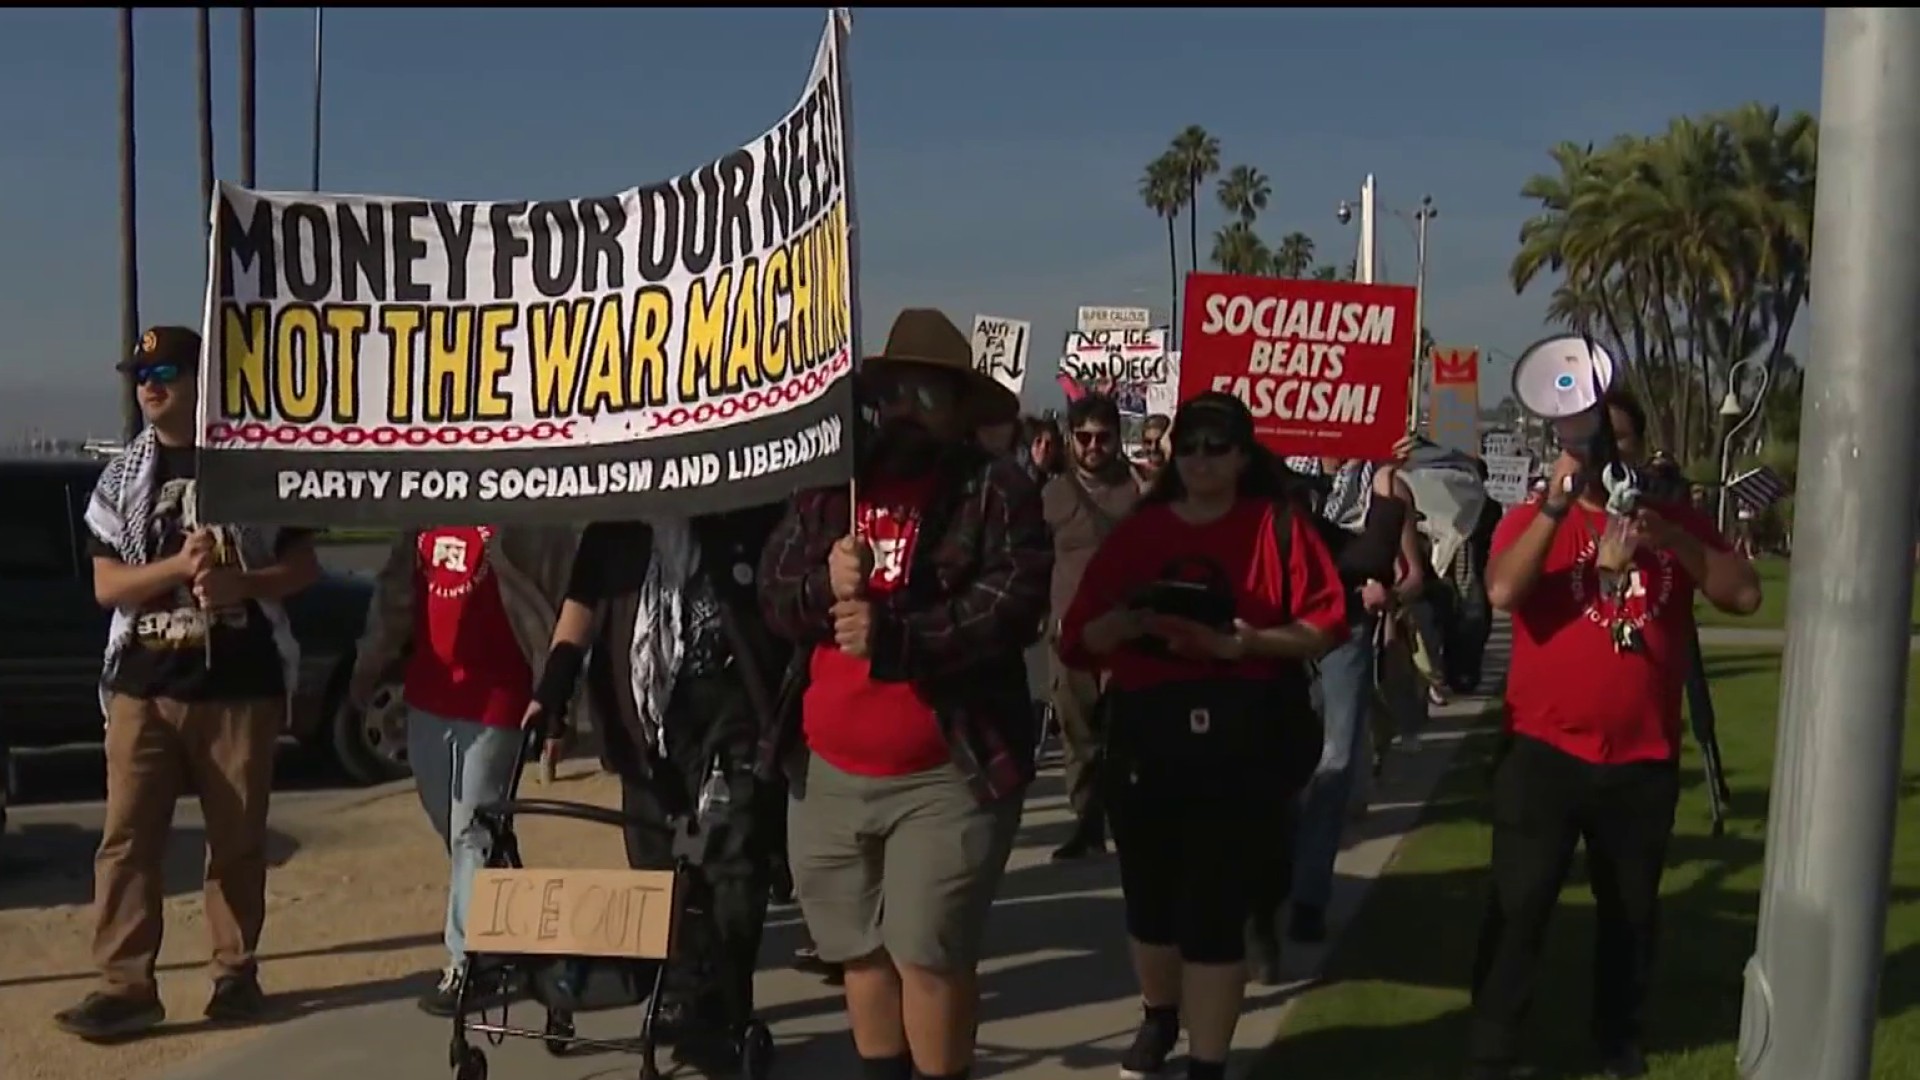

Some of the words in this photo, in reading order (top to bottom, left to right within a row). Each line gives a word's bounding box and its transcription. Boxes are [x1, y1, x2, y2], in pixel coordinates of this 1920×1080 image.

[221, 200, 476, 300] MONEY
[494, 197, 625, 300] FOR
[638, 148, 753, 281] OUR
[221, 301, 365, 425] NOT
[379, 302, 515, 424] THE
[527, 283, 669, 418] WAR
[678, 202, 849, 403] MACHIN
[1072, 330, 1110, 346] NO
[1123, 328, 1151, 344] ICE
[1202, 293, 1396, 345] SOCIALISM
[976, 353, 1004, 377] AF
[986, 336, 1005, 351] FA
[1248, 341, 1346, 381] BEATS
[1212, 376, 1381, 424] FASCISM!
[277, 469, 392, 499] PARTY
[401, 469, 469, 498] FOR
[479, 457, 653, 499] SOCIALISM
[659, 452, 721, 490] AND
[726, 413, 842, 476] LIBERATION
[432, 536, 467, 573] PSL
[478, 877, 564, 942] ICE
[569, 884, 667, 954] OUT
